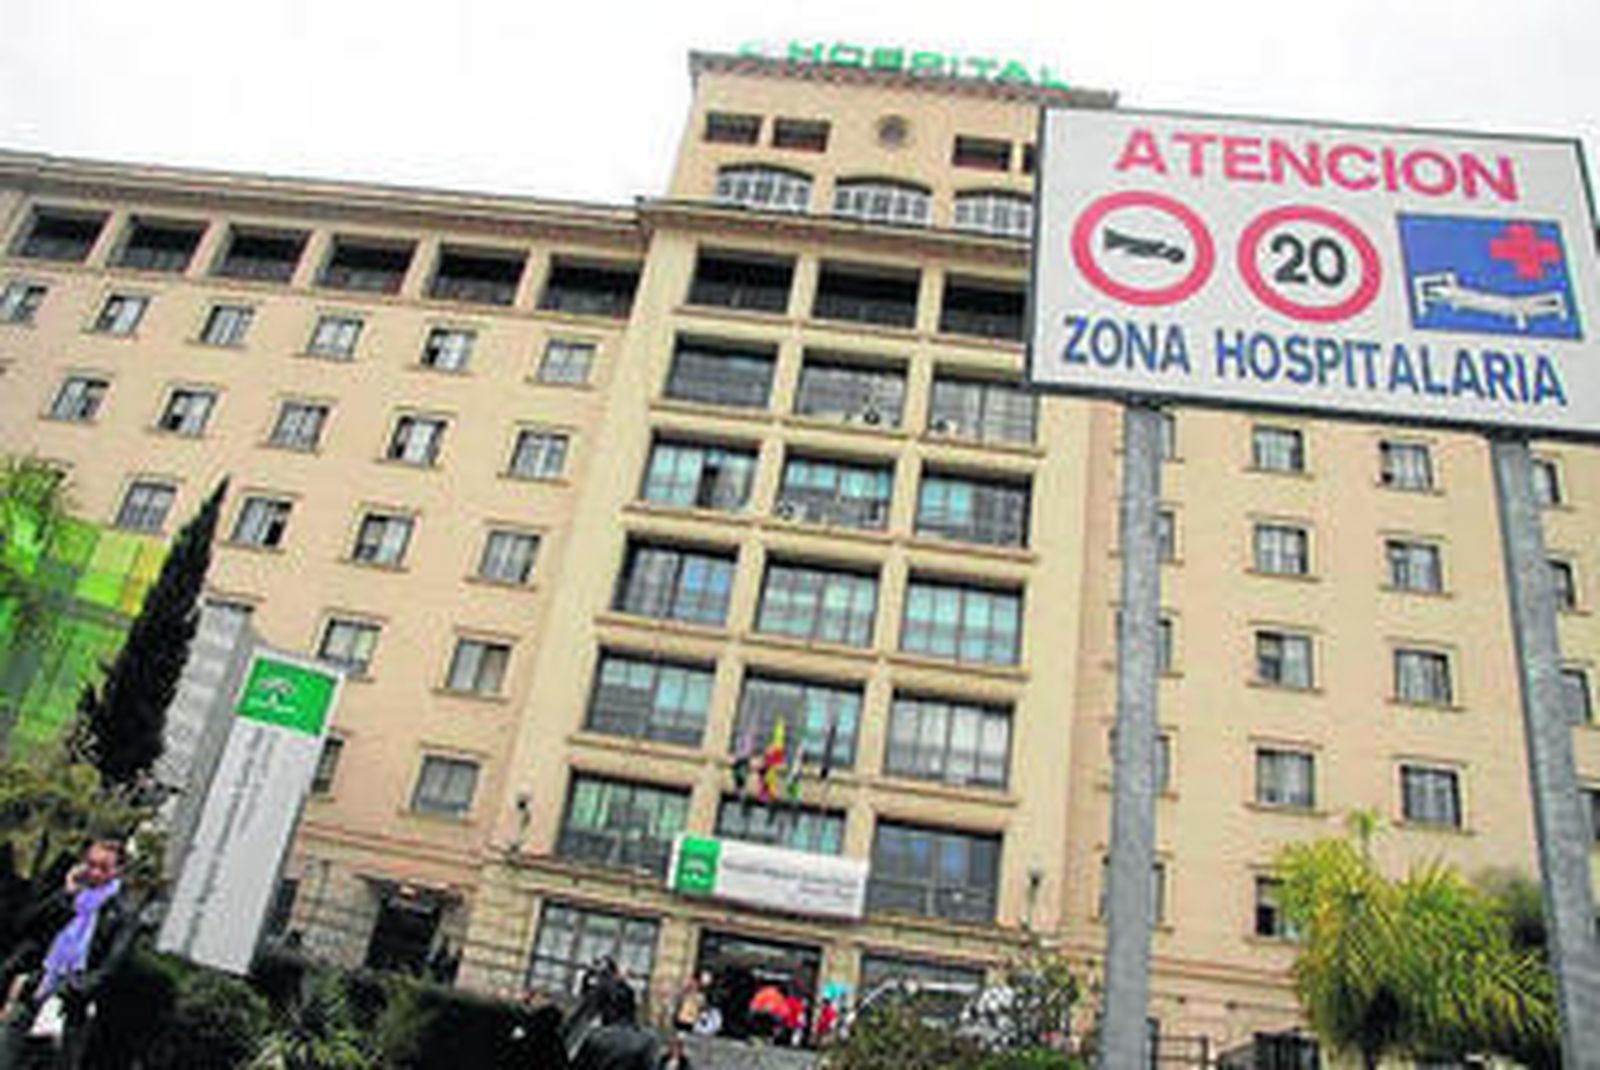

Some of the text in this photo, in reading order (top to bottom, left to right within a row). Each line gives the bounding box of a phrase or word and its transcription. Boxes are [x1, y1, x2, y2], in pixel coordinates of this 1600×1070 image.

[787, 40, 1071, 91] HOSPITAL
[1115, 129, 1519, 202] ATENCION
[1270, 234, 1346, 287] 20
[1062, 314, 1567, 407] ZONA HOSPITALARIA
